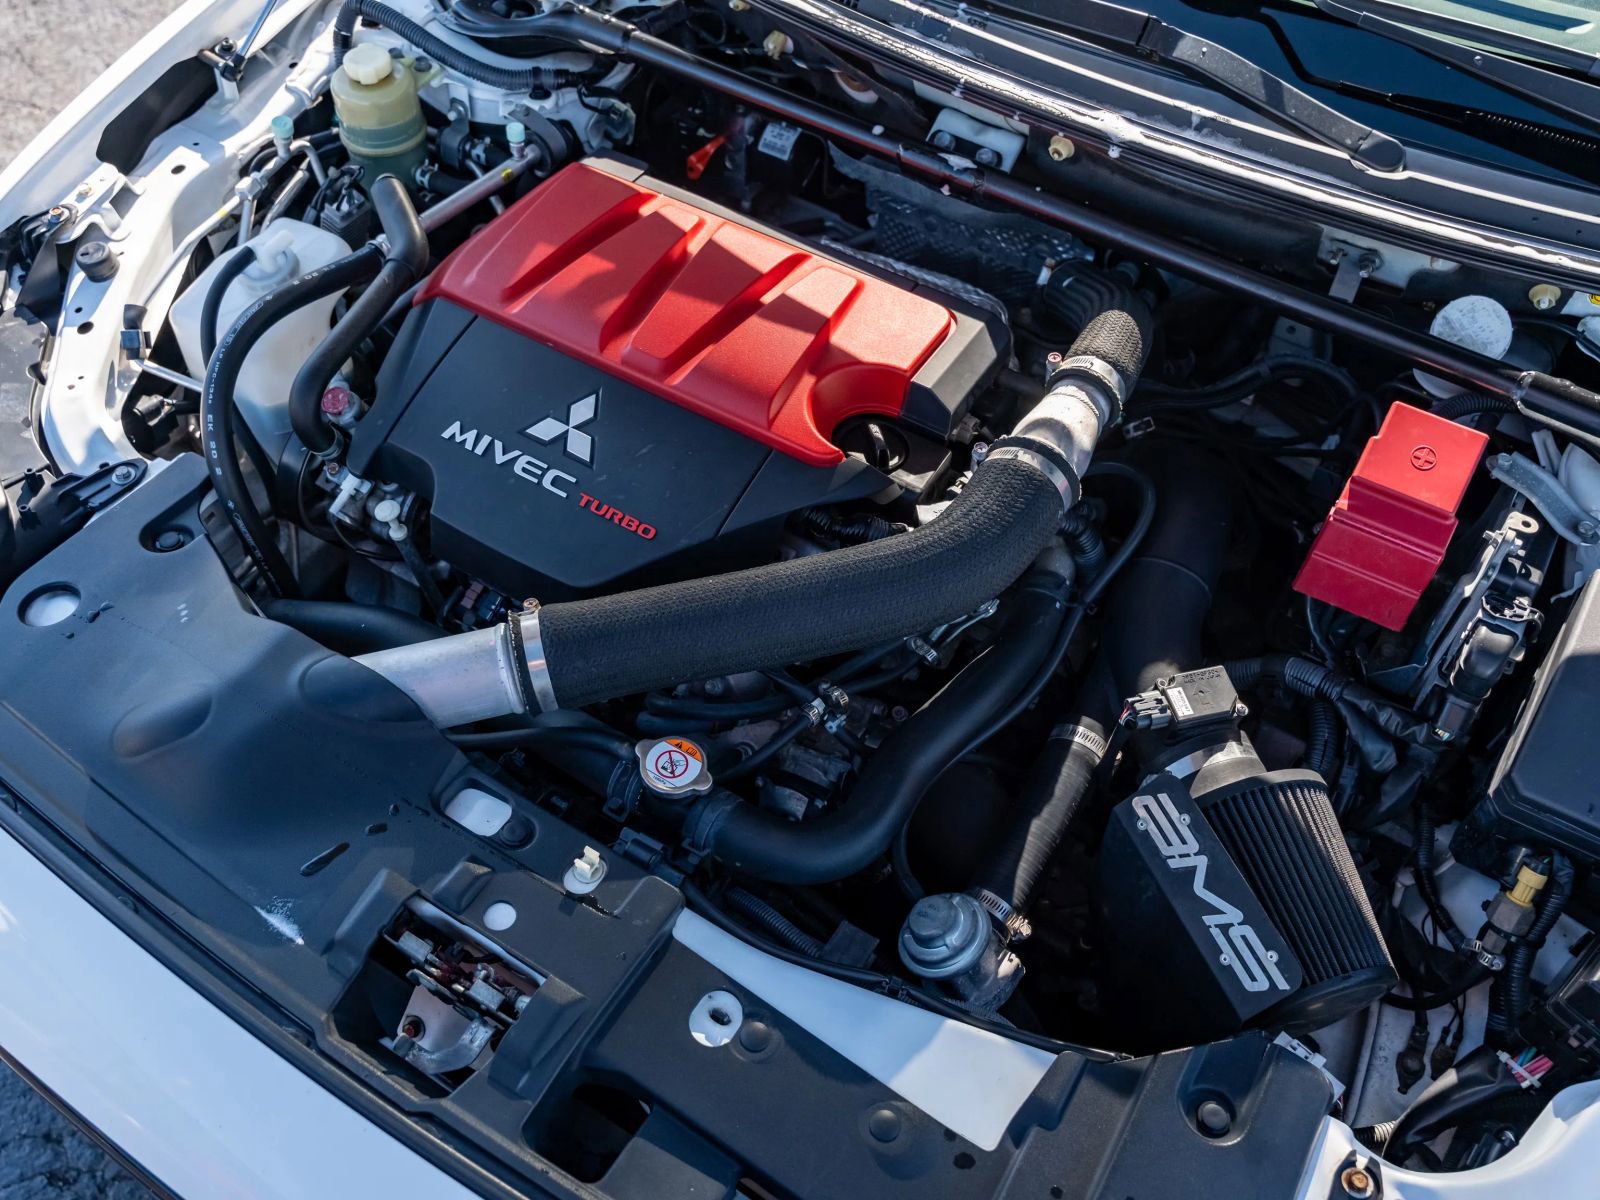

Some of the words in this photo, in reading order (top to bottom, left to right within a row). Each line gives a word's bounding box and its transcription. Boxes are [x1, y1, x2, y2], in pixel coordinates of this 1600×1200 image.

[207, 414, 215, 432] EK
[440, 420, 577, 498] MIVEC
[578, 492, 658, 540] TURBO
